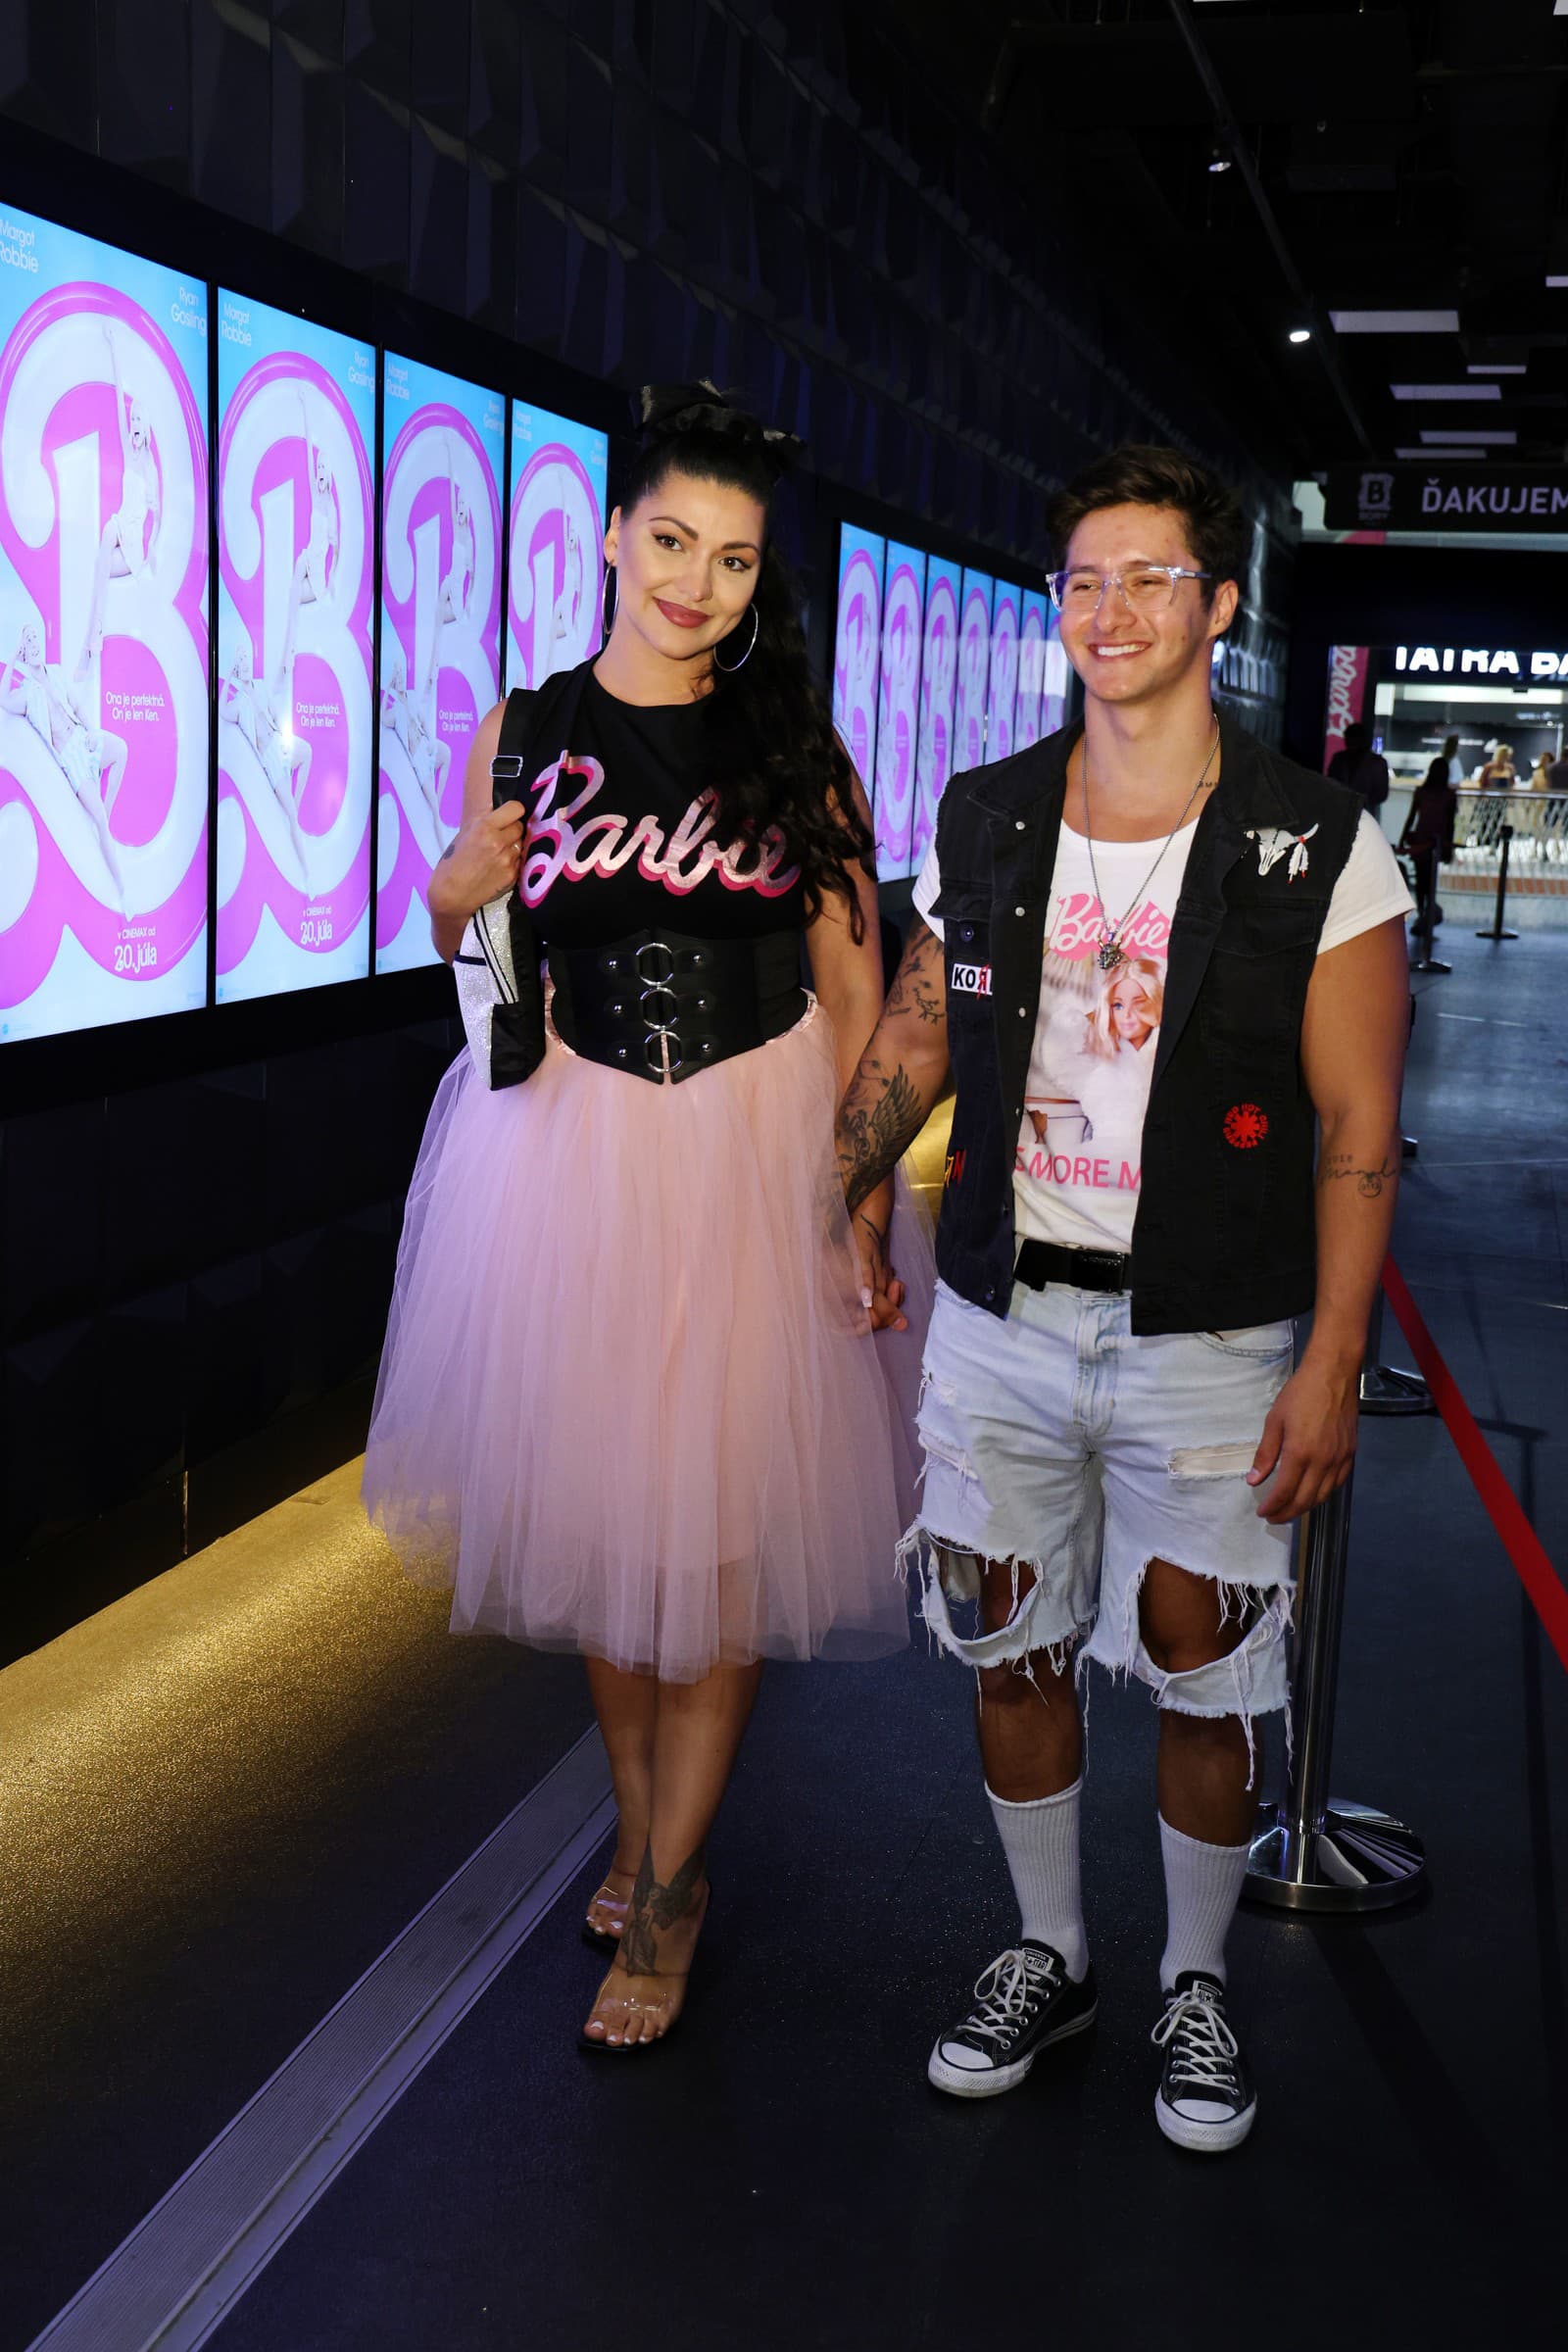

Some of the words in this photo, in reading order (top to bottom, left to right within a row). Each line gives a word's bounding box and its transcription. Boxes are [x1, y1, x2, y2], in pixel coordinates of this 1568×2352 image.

[0, 241, 39, 273] Robbie
[178, 286, 199, 307] Ryan
[171, 303, 207, 337] Gosling
[1421, 477, 1568, 514] ĎAKUJEM
[105, 691, 122, 705] Ona
[122, 693, 130, 708] je
[112, 707, 123, 720] On
[124, 708, 132, 721] je
[132, 708, 144, 721] len
[517, 749, 802, 908] Barbie
[1028, 1152, 1110, 1188] MORE
